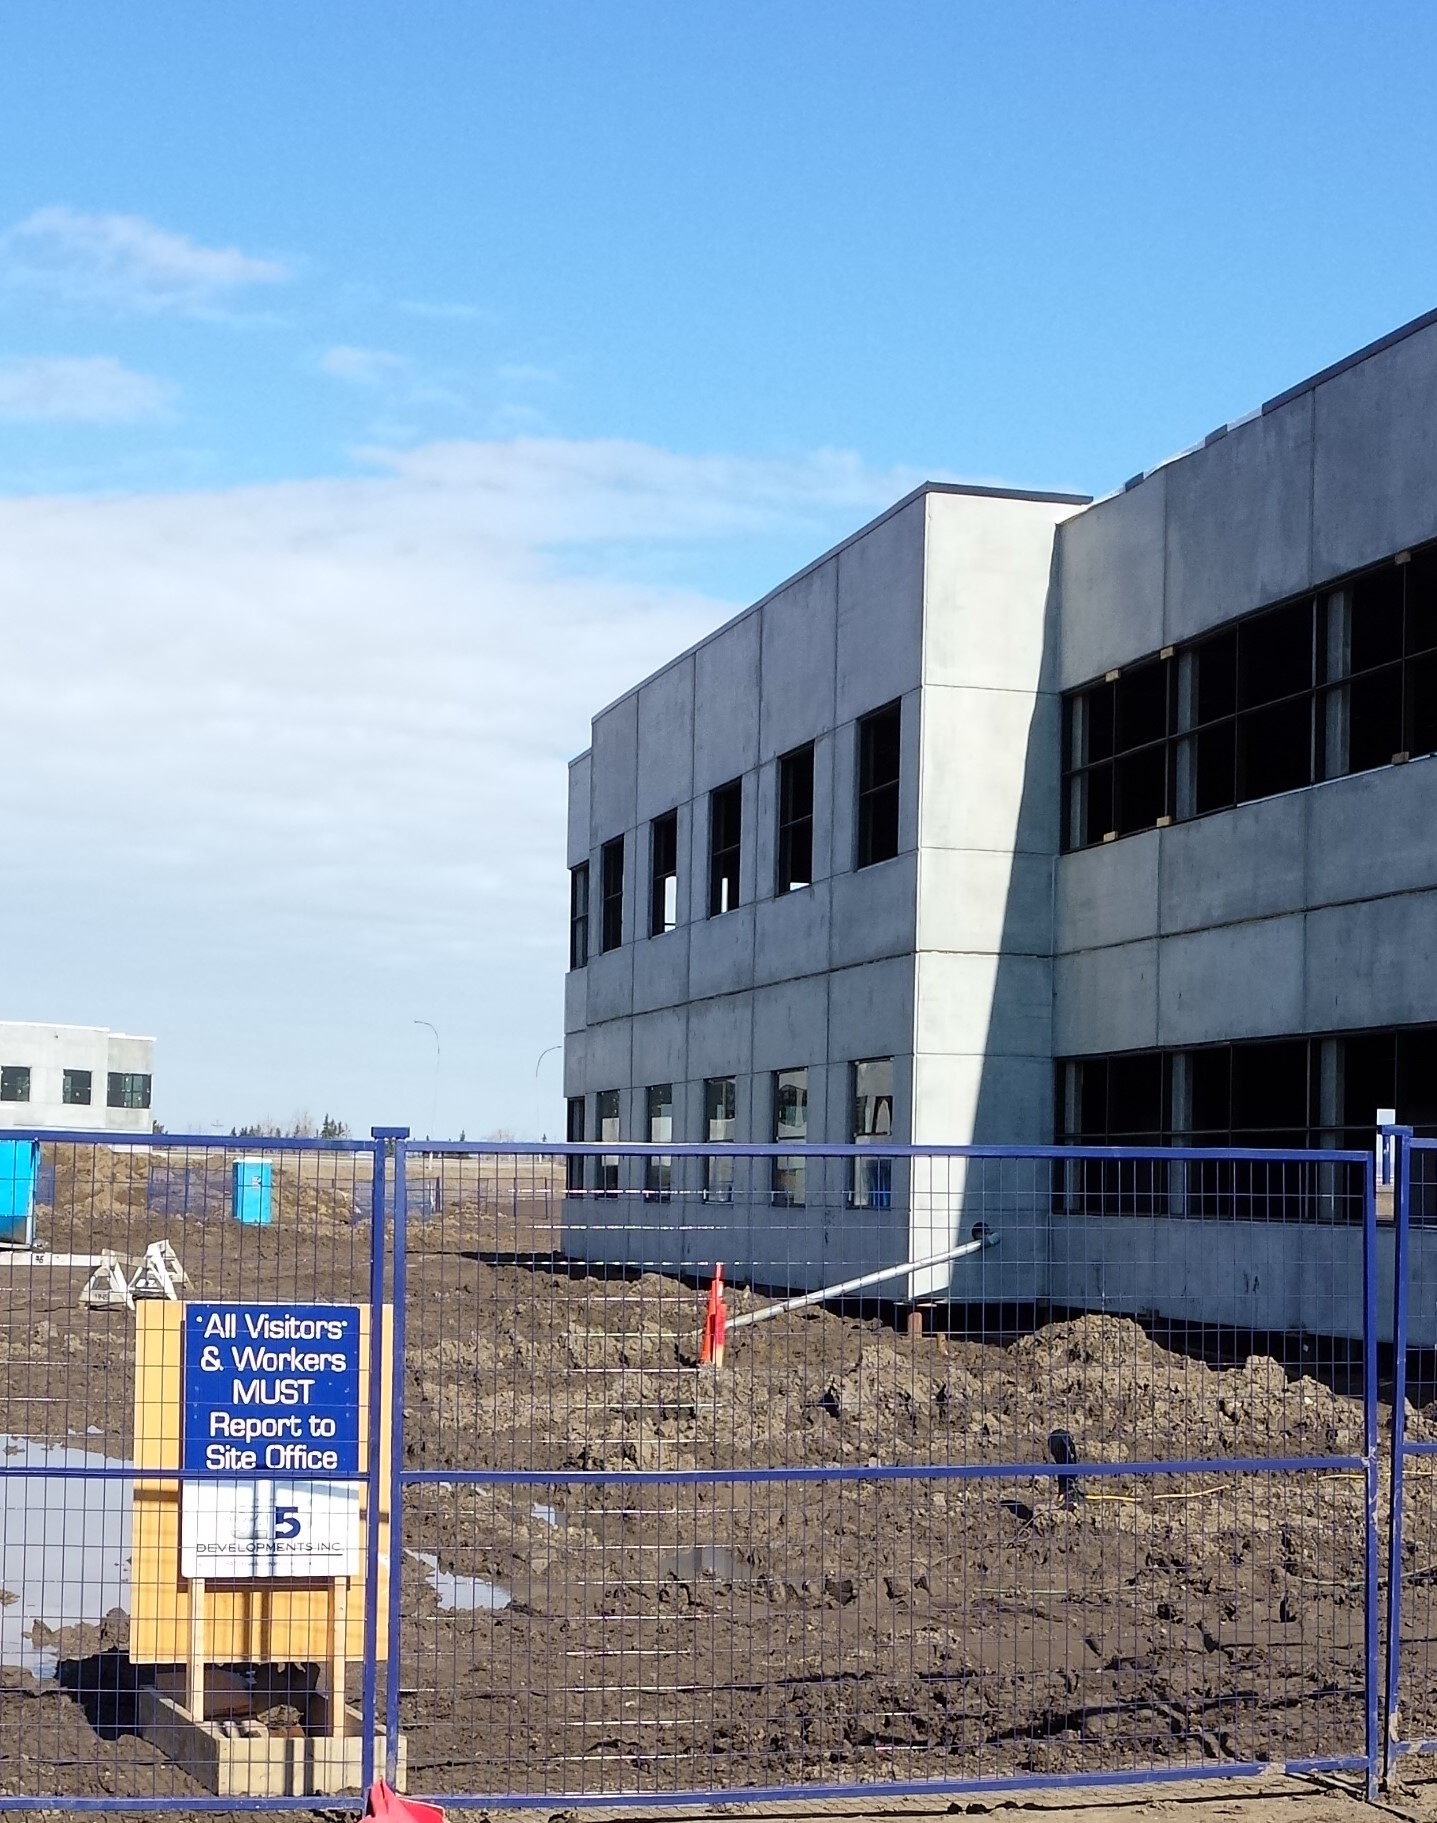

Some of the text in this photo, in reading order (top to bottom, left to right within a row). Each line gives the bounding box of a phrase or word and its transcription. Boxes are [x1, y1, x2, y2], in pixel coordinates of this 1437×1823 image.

[204, 1313, 342, 1339] All Visitors
[201, 1346, 346, 1371] & Workers
[233, 1379, 315, 1404] MUST
[210, 1412, 335, 1443] Report to
[206, 1444, 337, 1469] Site Office
[196, 1543, 312, 1552] DEVELOPMENTS
